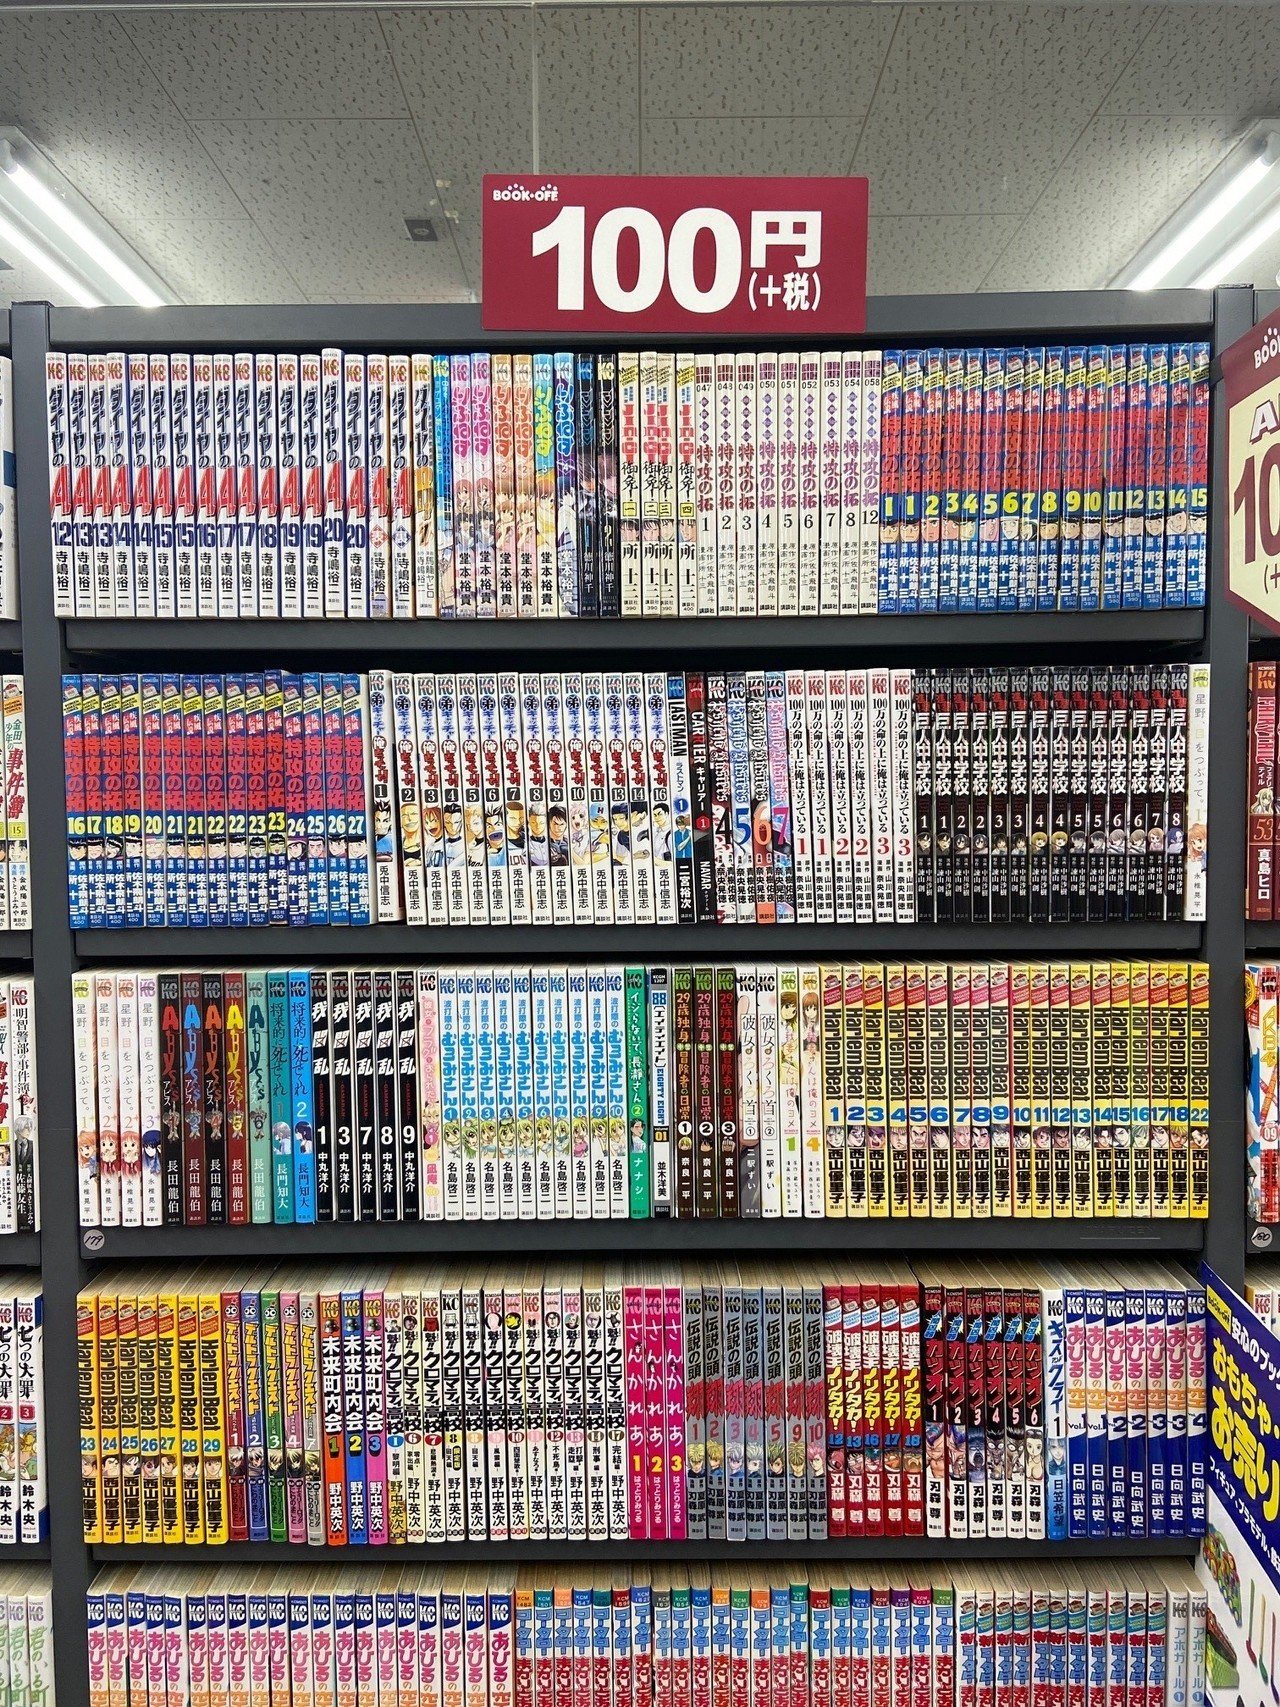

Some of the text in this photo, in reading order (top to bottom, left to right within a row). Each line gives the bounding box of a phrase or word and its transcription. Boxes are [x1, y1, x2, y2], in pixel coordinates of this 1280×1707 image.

[759, 441, 776, 509] 特攻の拓
[822, 441, 840, 508] 特攻の拓
[863, 440, 880, 506] 特攻の拓
[697, 445, 713, 531] 特攻の拓 1
[718, 445, 734, 530] 特攻の拓 2
[1126, 490, 1144, 509] 12
[1169, 489, 1186, 509] 14
[884, 497, 894, 516] 1
[926, 495, 939, 515] 2
[946, 493, 959, 513] 3
[984, 494, 998, 514] 5
[1003, 492, 1018, 513] 6
[1042, 492, 1057, 512] 8
[1066, 491, 1081, 511] 9
[1084, 492, 1101, 511] 10
[742, 516, 751, 530] 3
[762, 514, 771, 528] 4
[784, 514, 793, 527] 5
[827, 513, 835, 527] 7
[846, 513, 855, 526] 8
[862, 511, 878, 524] 12
[51, 522, 71, 547] 12
[73, 522, 93, 547] 13
[93, 522, 113, 547] 13
[132, 522, 152, 547] 14
[174, 522, 195, 547] 15
[197, 523, 216, 547] 16
[217, 523, 236, 547] 17
[260, 524, 277, 548] 18
[282, 523, 299, 547] 19
[325, 518, 343, 542] 20
[347, 524, 365, 548] 20
[479, 552, 492, 604] 堂本裕貴
[500, 553, 512, 605] 堂本裕貴
[541, 552, 553, 606] 堂本裕貴
[7, 748, 25, 819] 事件簿
[671, 702, 687, 757] LASTMAN
[679, 865, 692, 909] 二宮裕次
[68, 817, 85, 834] 16
[125, 815, 140, 833] 19
[146, 816, 162, 834] 20
[229, 816, 245, 833] 22
[269, 812, 285, 831] 23
[288, 818, 305, 836] 24
[328, 816, 345, 834] 26
[349, 817, 363, 835] 27
[736, 808, 750, 846] 5
[755, 805, 772, 846] 6
[773, 807, 789, 845] 7
[1035, 813, 1044, 826] 4
[1113, 813, 1121, 827] 6
[1172, 812, 1180, 826] 8
[797, 838, 808, 856] 1
[877, 836, 890, 854] 3
[1255, 819, 1274, 899] 53 真島ヒロ
[700, 861, 712, 890] NAVAR
[652, 993, 667, 1005] 88
[993, 1104, 1009, 1120] 9
[1170, 1107, 1188, 1122] 18
[1192, 1108, 1209, 1122] 22
[360, 1126, 373, 1193] 7 中丸洋介
[403, 1126, 416, 1193] 9 中丸洋介
[318, 1152, 330, 1193] 中丸洋介
[447, 1161, 458, 1204] 名島啓二
[522, 1161, 533, 1203] 名島啓二
[613, 1159, 624, 1202] 名島啓二
[682, 1157, 691, 1200] 奈良一平
[167, 1159, 180, 1213] 長田龍伯
[231, 1158, 244, 1212] 長田龍伯
[364, 1335, 383, 1431] 未来町内会
[645, 1319, 663, 1448] さんかれあ
[665, 1319, 682, 1447] さんかれあ
[17, 1326, 35, 1525] 七つの大罪 鈴木央
[323, 1335, 342, 1531] 未来町内会 野中英次
[1068, 1325, 1086, 1521] あひるの空 日向武史
[1127, 1324, 1145, 1527] あひるの空 日向武史
[1187, 1324, 1206, 1520] あひるの空 日向武史
[102, 1437, 117, 1450] 24
[182, 1438, 198, 1451] 28
[408, 1477, 420, 1527] 野中英次
[551, 1476, 563, 1525] 野中英次
[1174, 1627, 1186, 1688] アホガール
[1193, 1627, 1205, 1688] アホガール
